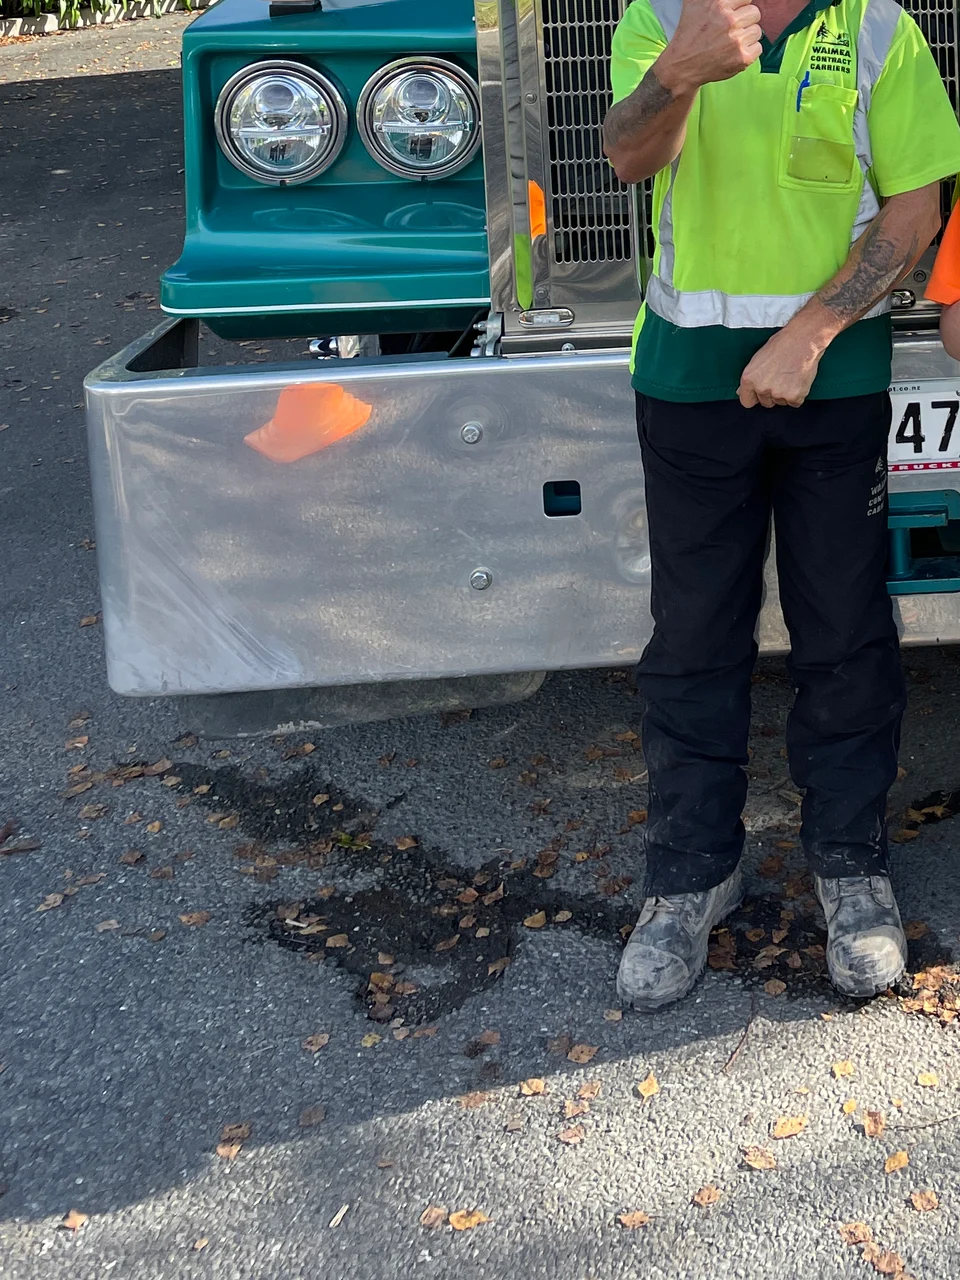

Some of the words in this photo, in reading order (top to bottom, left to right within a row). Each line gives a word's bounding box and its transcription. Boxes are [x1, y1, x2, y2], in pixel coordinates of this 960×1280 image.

[812, 46, 851, 58] WAIMEA
[810, 55, 852, 66] CONTRACT
[810, 63, 851, 74] CARRIERS
